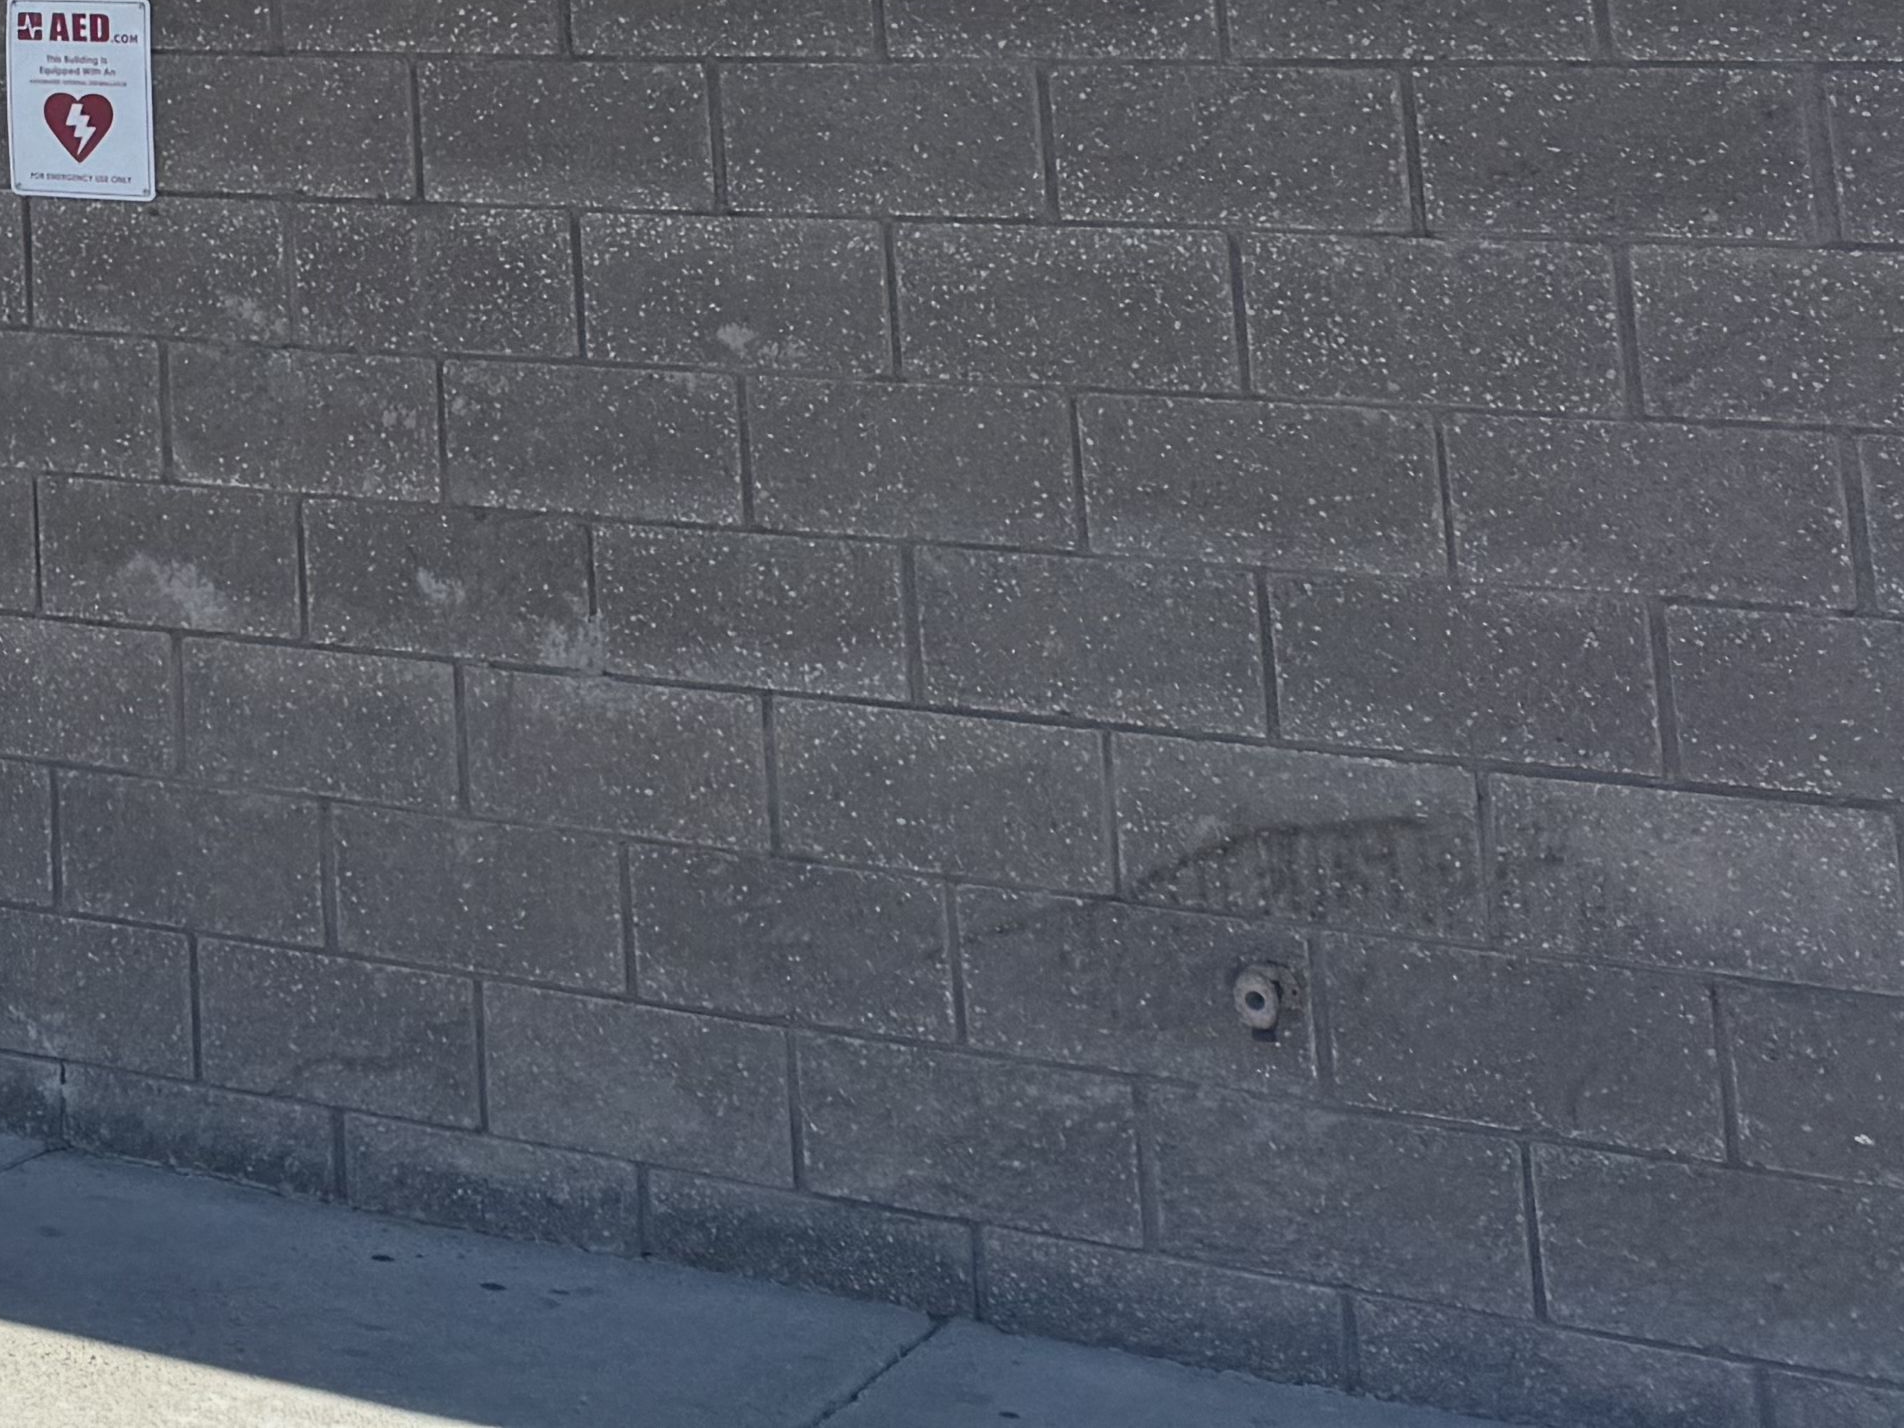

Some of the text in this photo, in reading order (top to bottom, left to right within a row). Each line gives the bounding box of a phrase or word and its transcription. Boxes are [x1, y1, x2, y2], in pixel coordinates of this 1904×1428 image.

[46, 54, 61, 63] This
[64, 55, 98, 66] Building
[39, 66, 80, 76] Equipped
